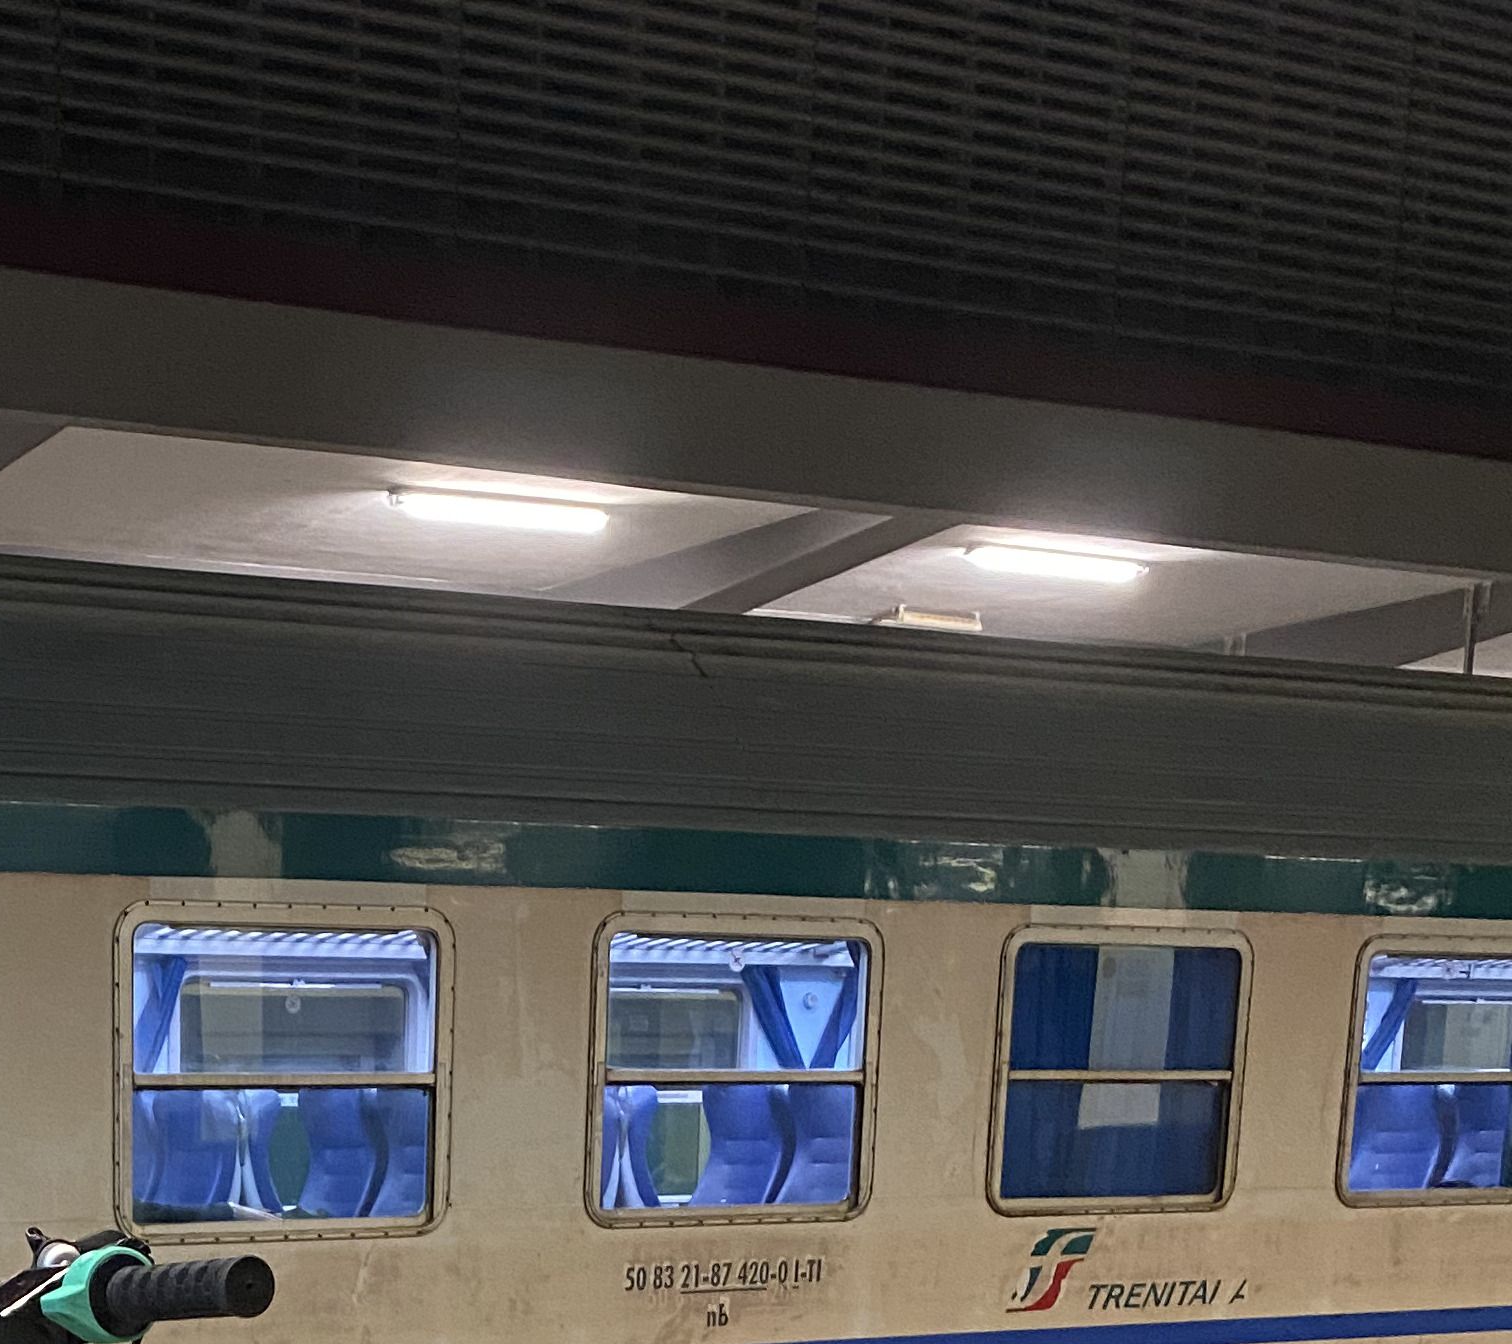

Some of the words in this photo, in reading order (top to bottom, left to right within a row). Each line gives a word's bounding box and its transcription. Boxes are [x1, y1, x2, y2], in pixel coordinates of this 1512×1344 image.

[624, 1266, 647, 1291] 50
[653, 1264, 674, 1289] 83
[681, 1262, 732, 1289] 21-87
[738, 1260, 788, 1285] 420-0
